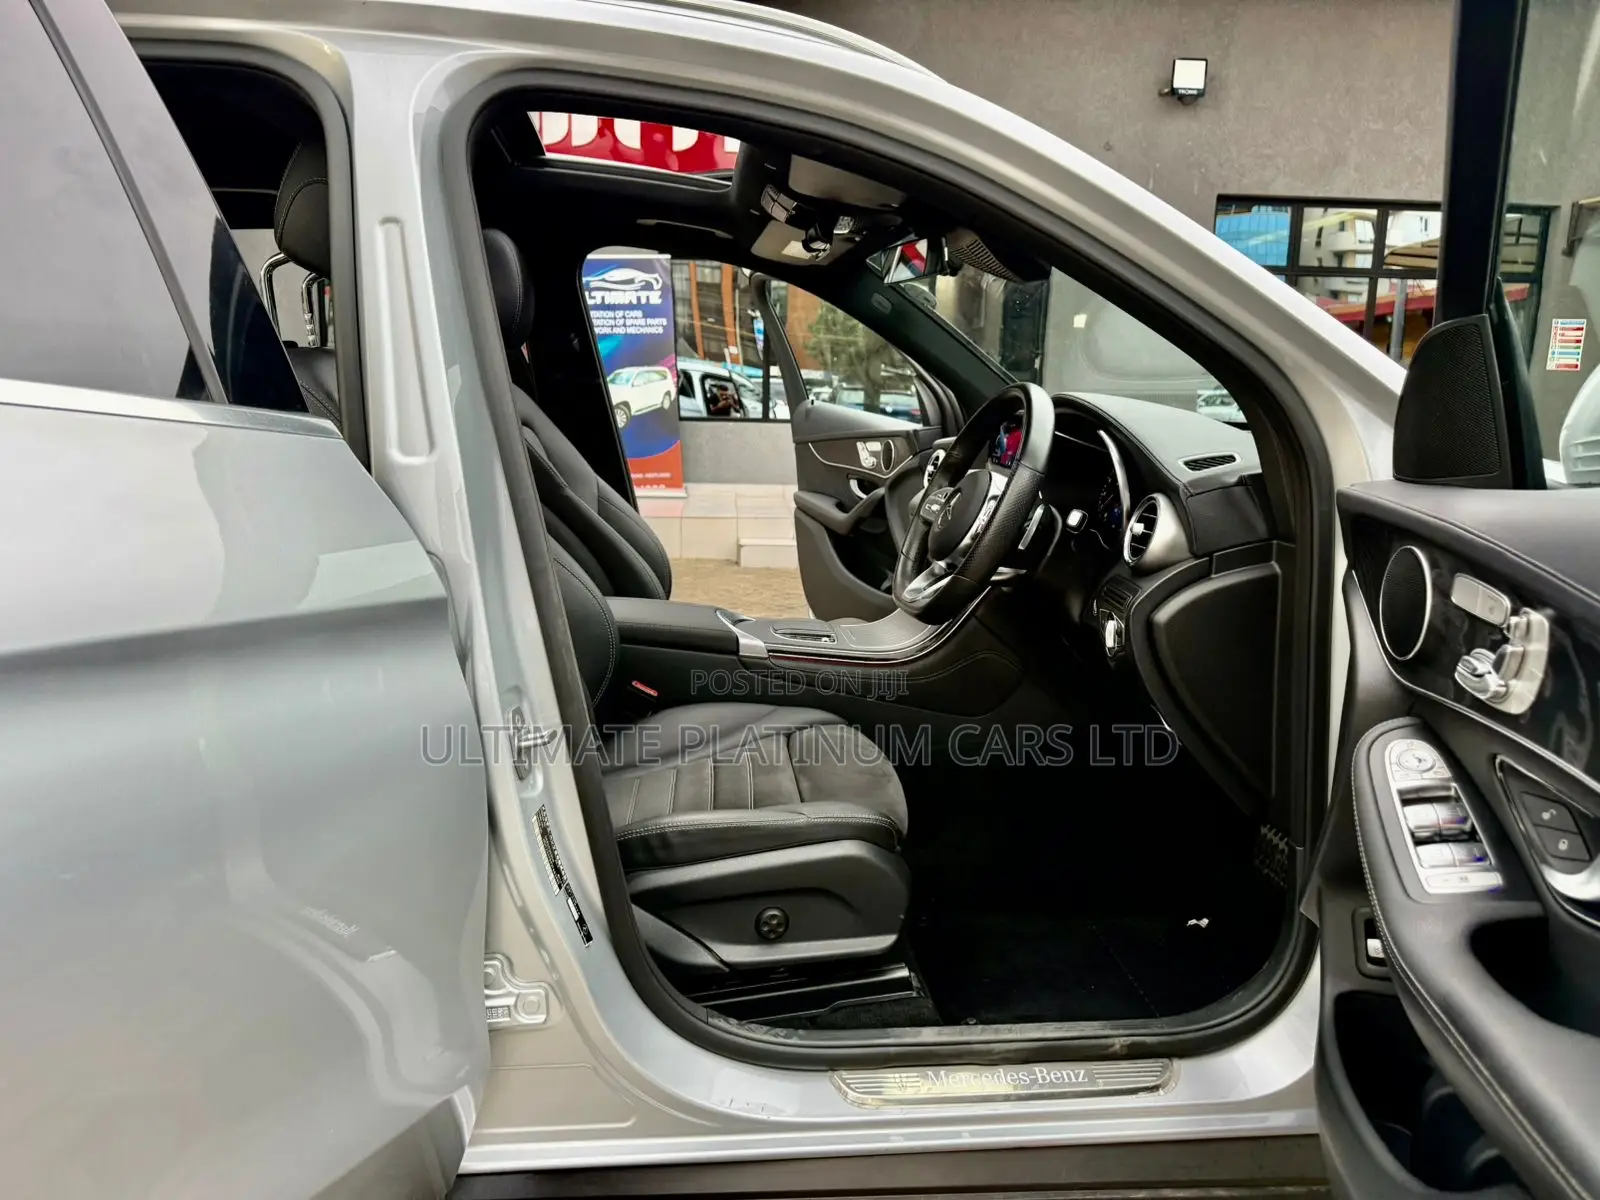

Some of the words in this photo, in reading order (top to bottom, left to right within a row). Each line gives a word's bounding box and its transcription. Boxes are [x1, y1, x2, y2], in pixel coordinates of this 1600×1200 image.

[615, 310, 624, 318] OF
[615, 318, 625, 326] OF
[646, 318, 667, 326] PARTS
[926, 1066, 1088, 1087] Mercedes-Benz
